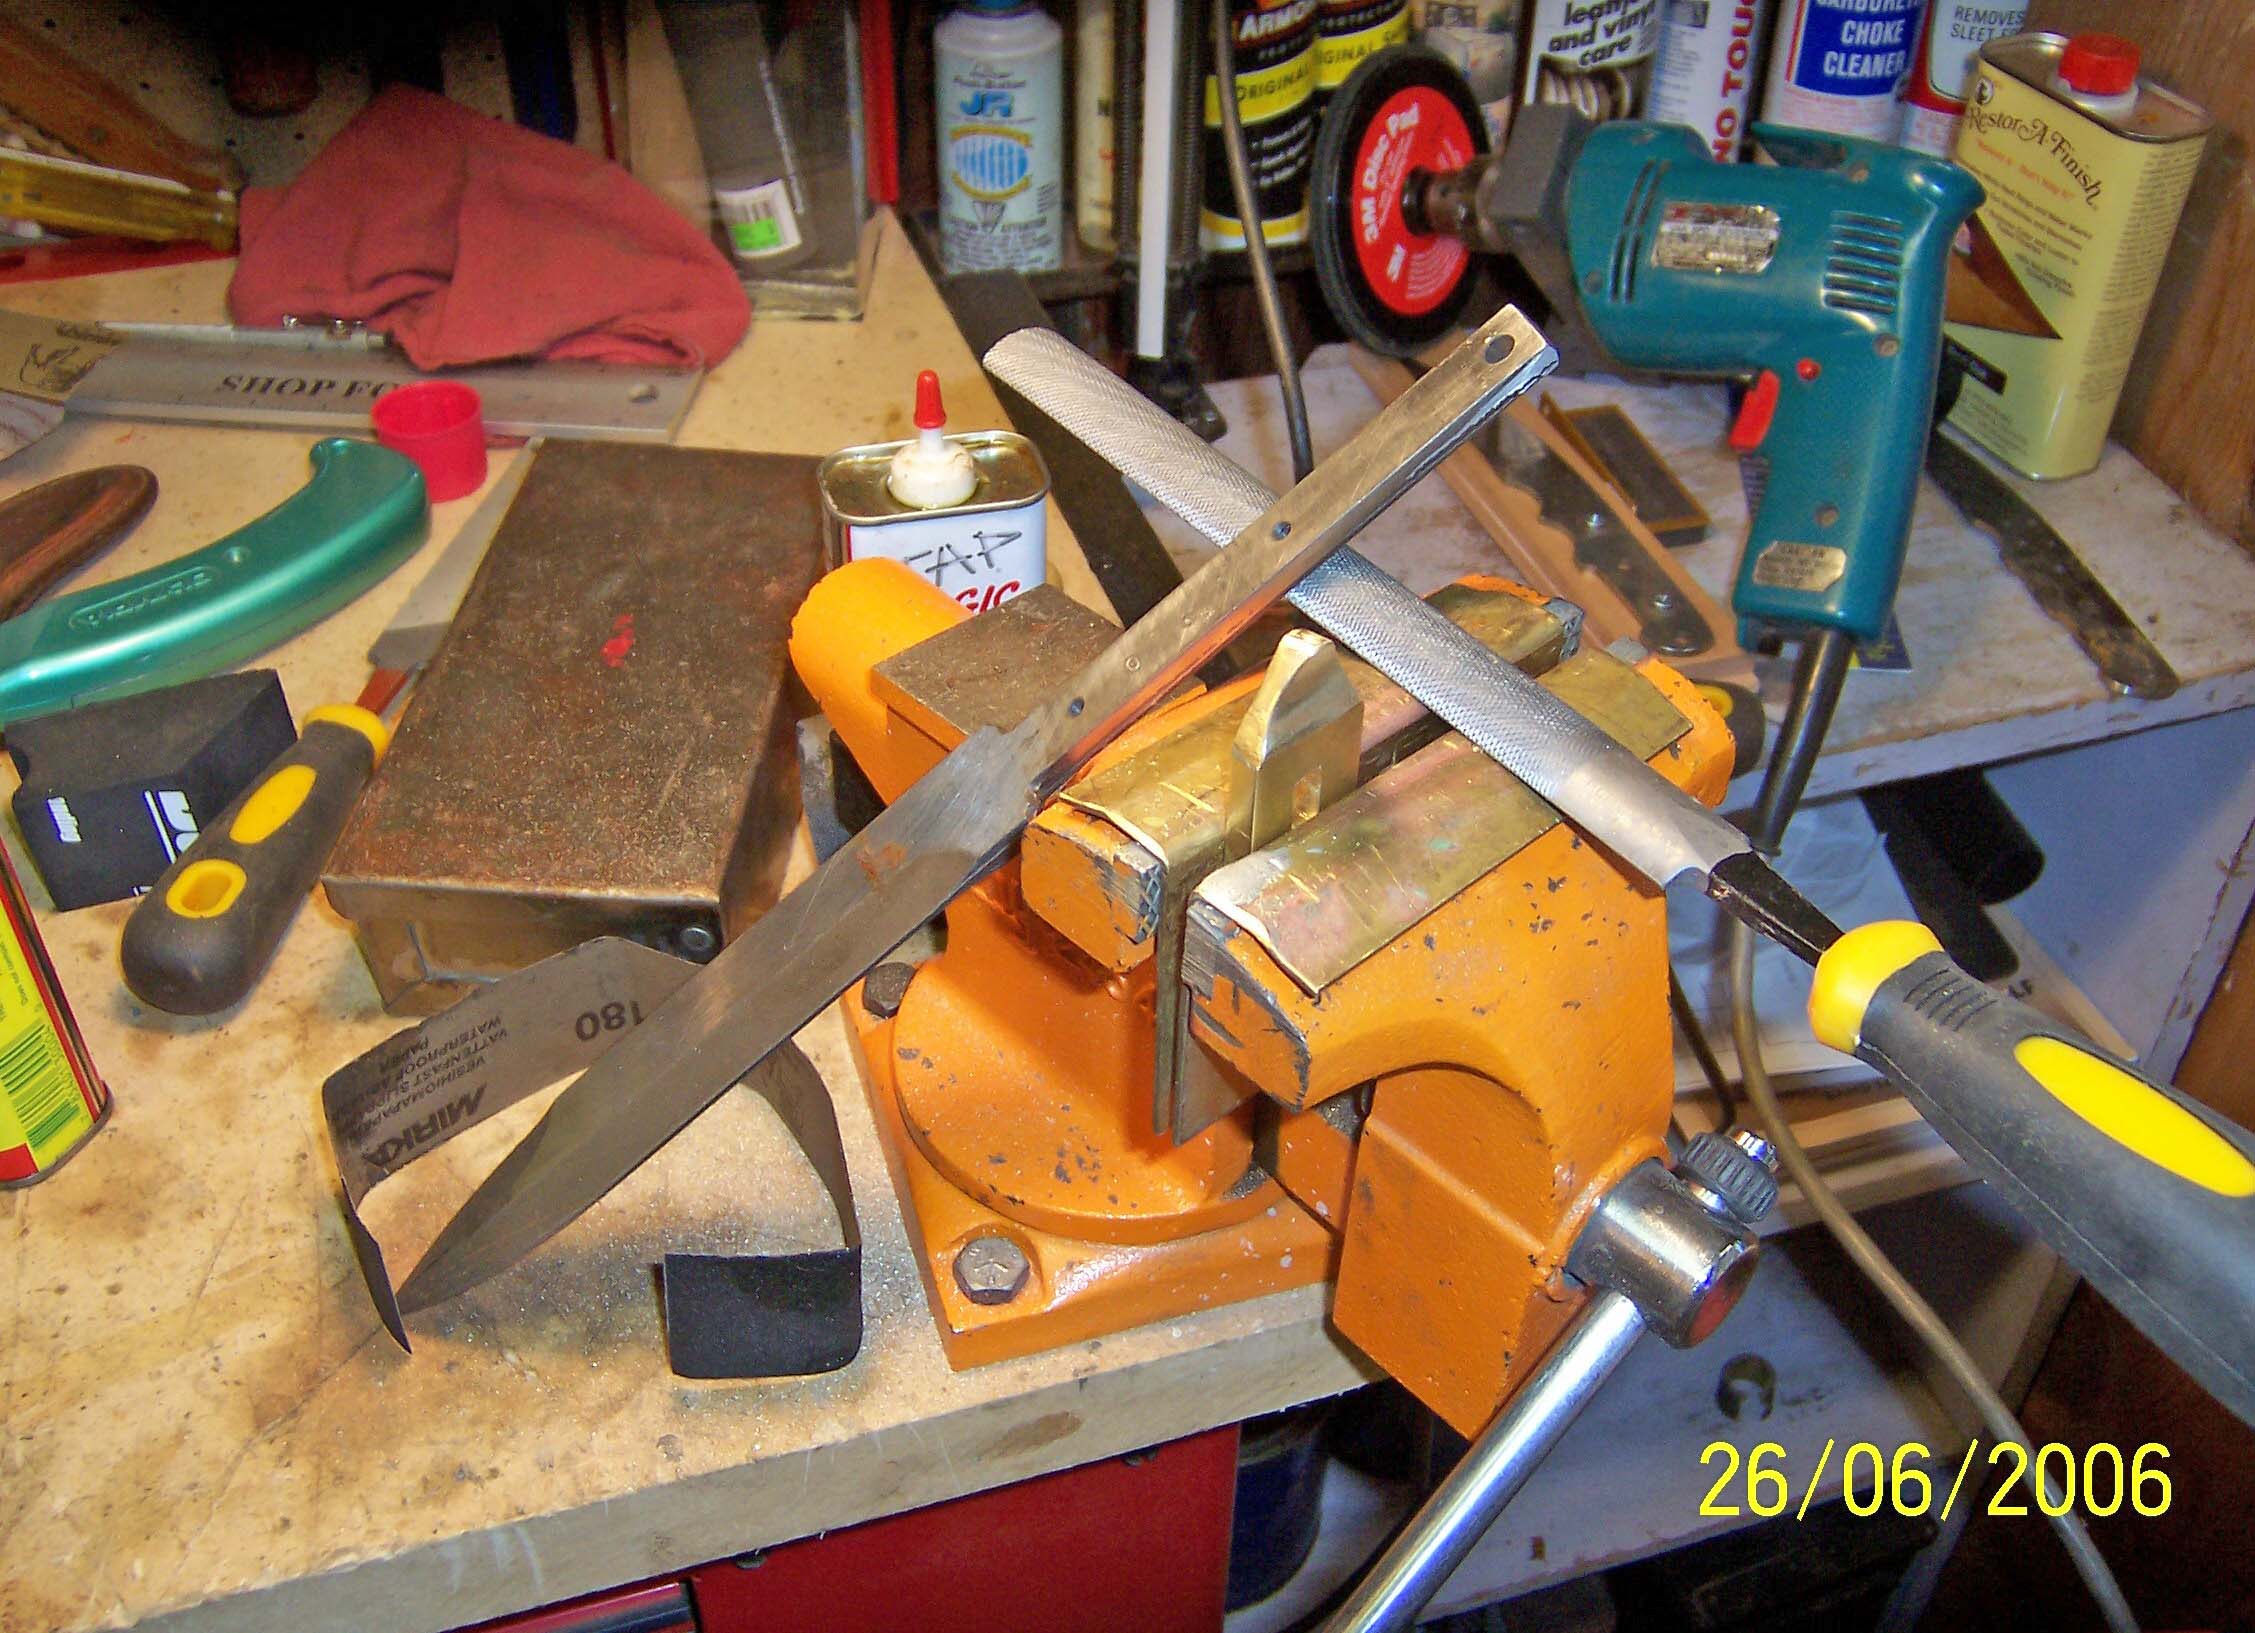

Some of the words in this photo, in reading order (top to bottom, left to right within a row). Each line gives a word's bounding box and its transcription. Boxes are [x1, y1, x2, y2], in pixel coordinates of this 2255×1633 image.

[1954, 6, 2026, 25] REMOVES
[1549, 20, 1599, 52] and
[1841, 19, 1906, 46] CHOKE
[1579, 33, 1633, 66] care
[1721, 0, 1756, 98] TOU
[1822, 50, 1907, 78] CLEANER
[215, 375, 337, 396] SHOP
[343, 380, 400, 398] FO
[955, 580, 1021, 614] GIC
[575, 1001, 643, 1042] 180
[361, 1081, 488, 1167] MIRKA
